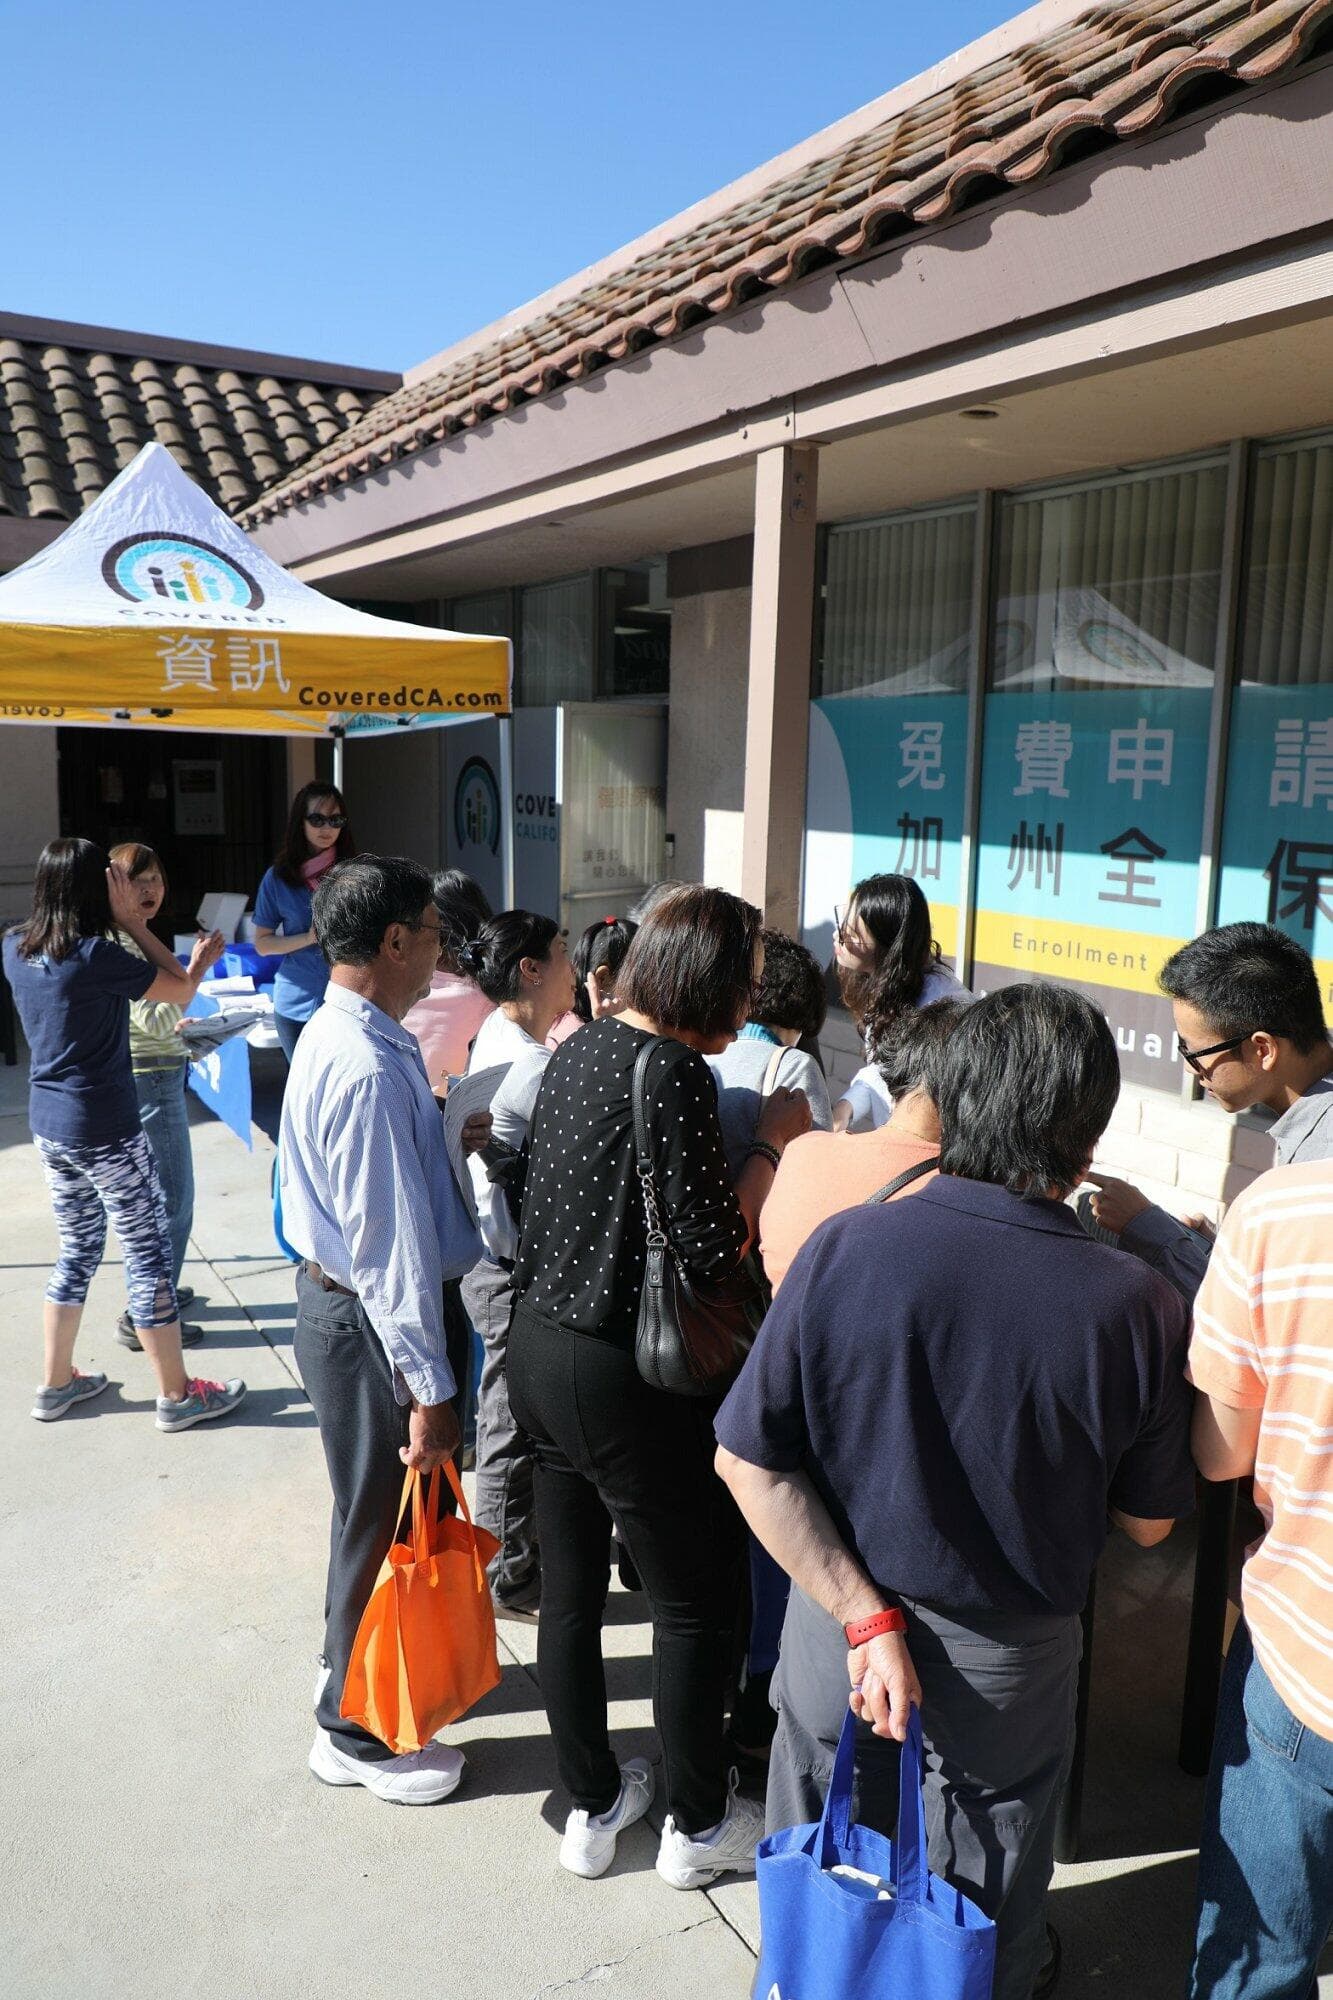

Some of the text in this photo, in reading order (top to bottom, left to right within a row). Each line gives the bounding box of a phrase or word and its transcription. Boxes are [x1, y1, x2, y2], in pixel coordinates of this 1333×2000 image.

[156, 634, 291, 693] 資訊
[298, 686, 503, 707] CoveredCA.com
[1012, 932, 1148, 971] Enrollment
